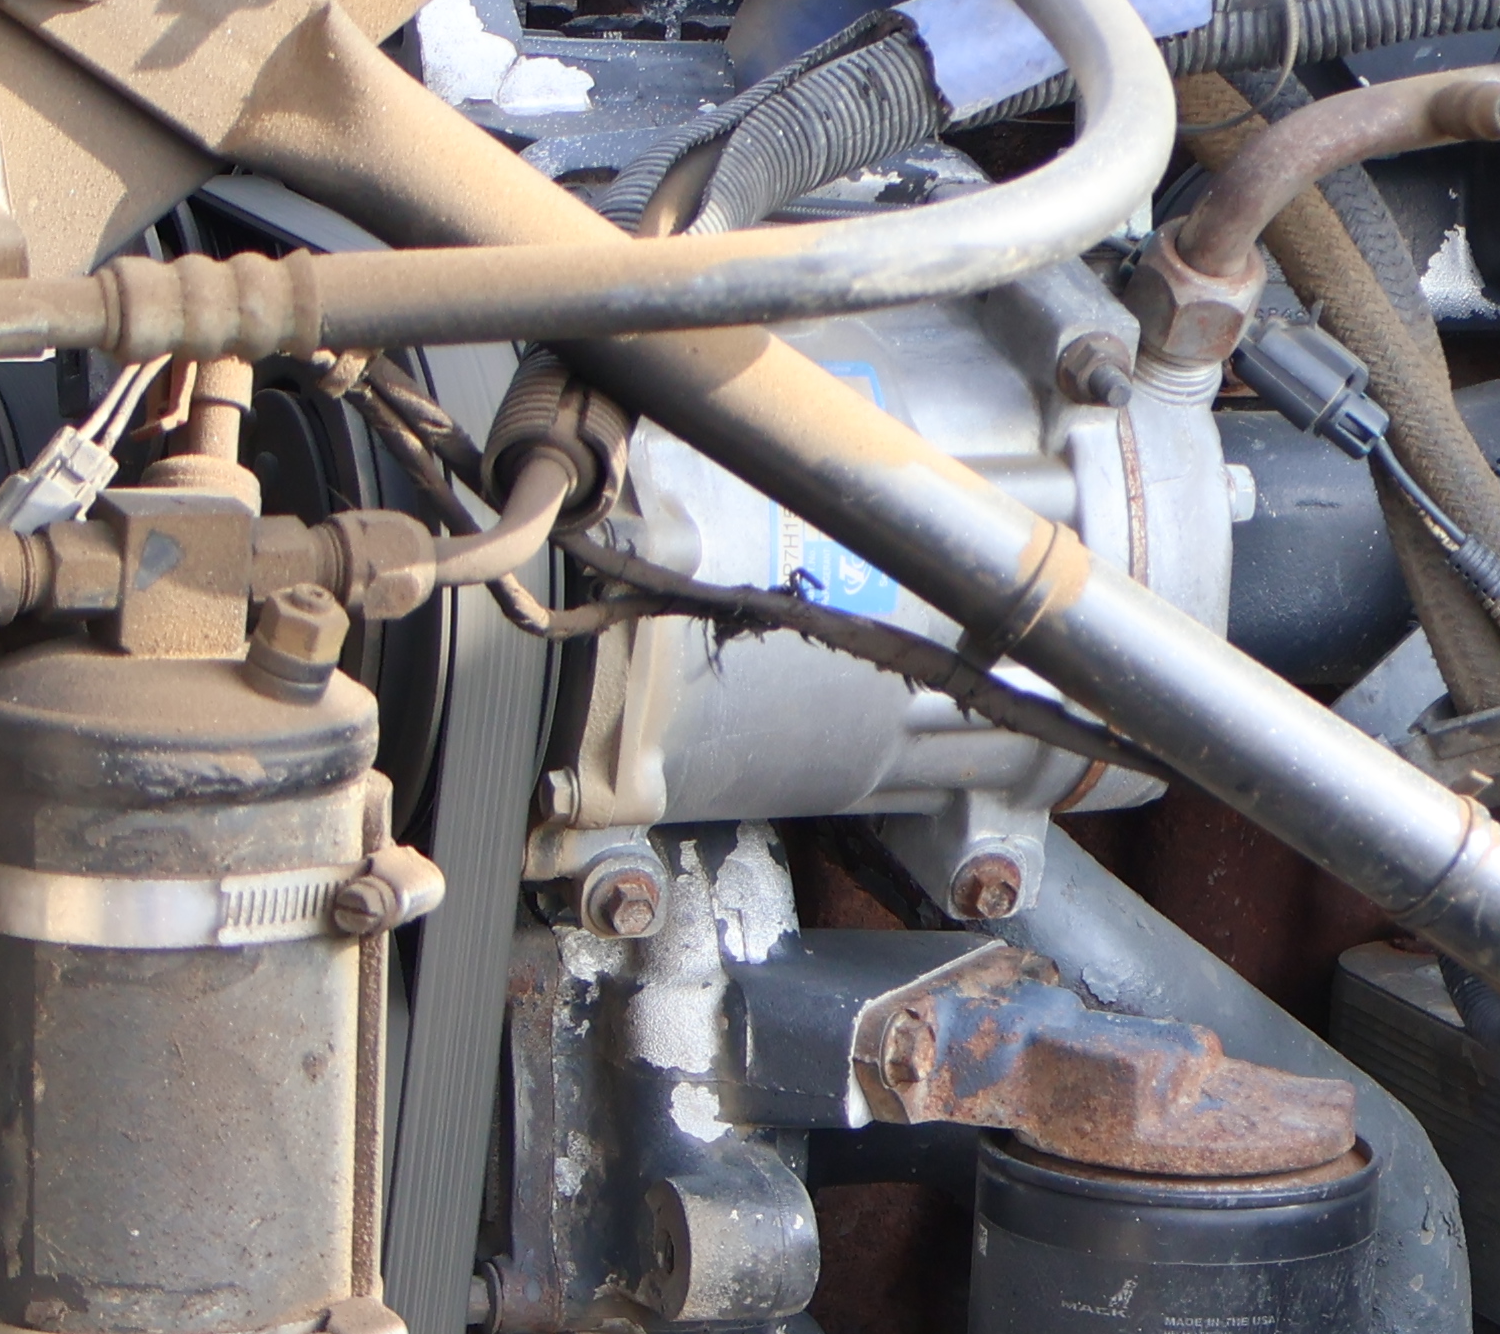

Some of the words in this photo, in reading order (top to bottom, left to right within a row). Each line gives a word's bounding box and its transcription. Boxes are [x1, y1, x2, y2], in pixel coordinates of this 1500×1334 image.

[1060, 1299, 1131, 1319] MACK
[1164, 1317, 1203, 1327] MADE
[1207, 1317, 1220, 1327] IN
[1252, 1315, 1276, 1326] USA
